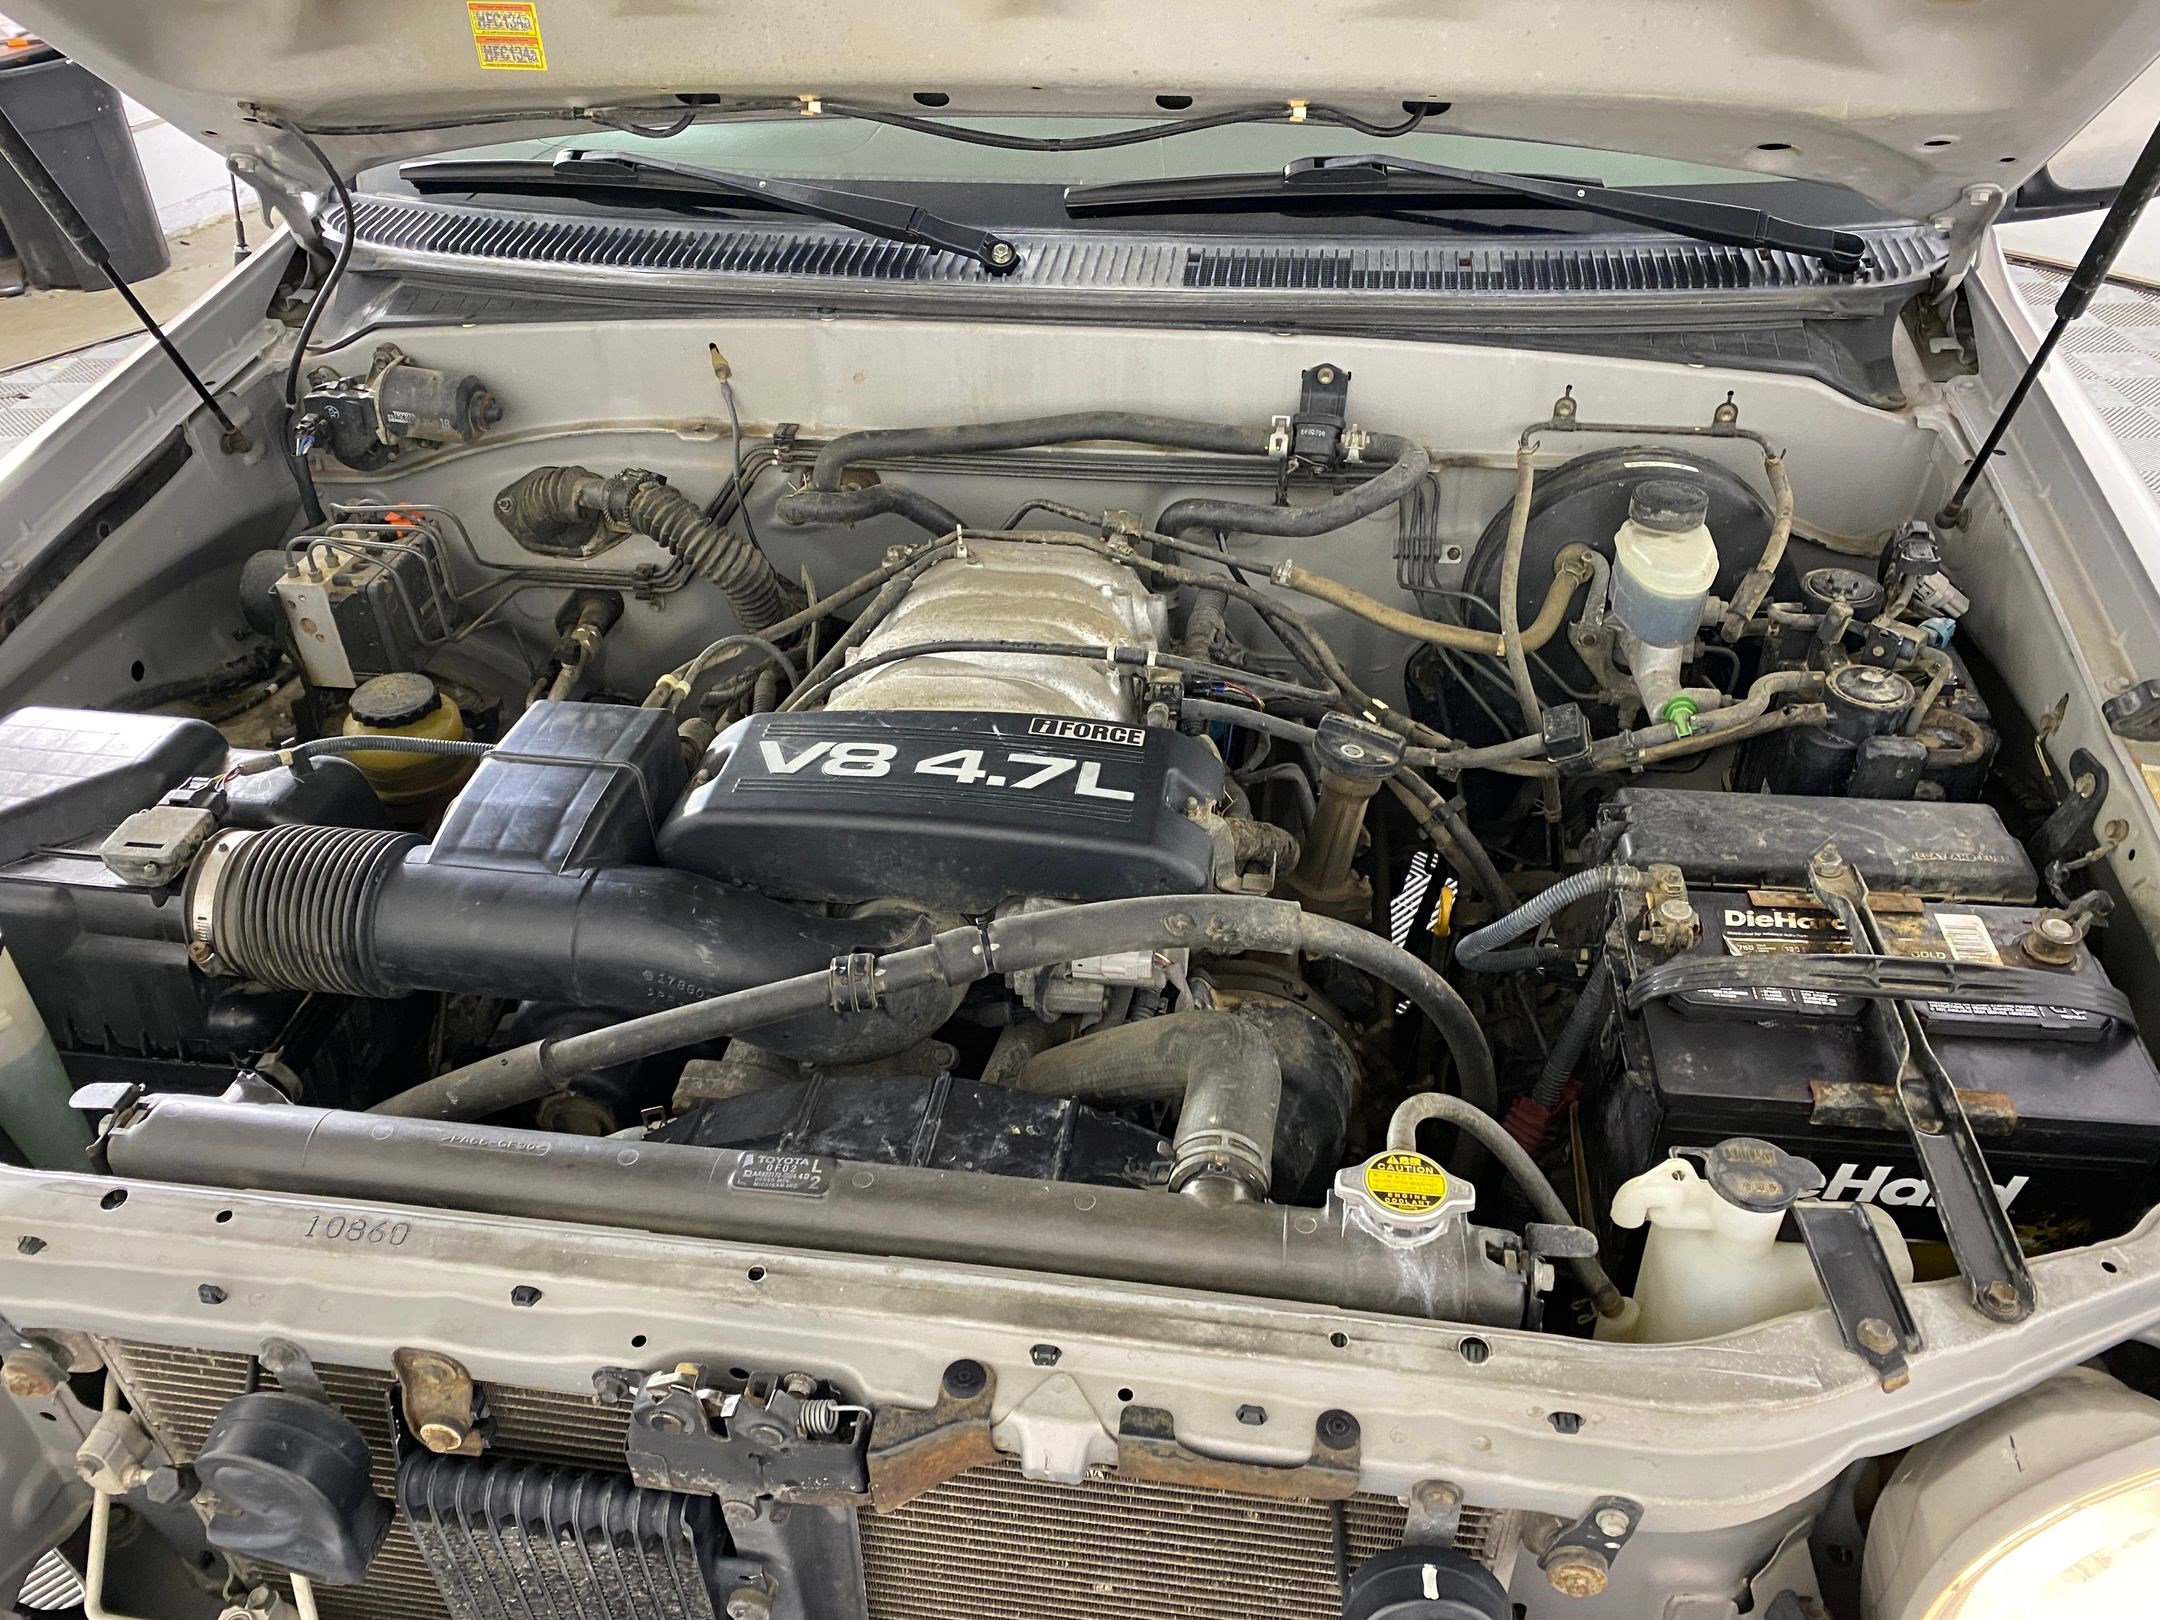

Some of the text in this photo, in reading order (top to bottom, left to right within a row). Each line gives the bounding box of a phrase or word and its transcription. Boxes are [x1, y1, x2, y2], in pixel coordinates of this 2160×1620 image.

[1058, 721, 1143, 745] FORCE
[758, 740, 1135, 801] V8 4.7L
[758, 1155, 809, 1166] TOYOTA
[1377, 1162, 1434, 1174] CAUTION
[1384, 1197, 1432, 1207] COOLANT
[1387, 1192, 1428, 1201] ENGINE
[303, 1214, 412, 1246] 10860
